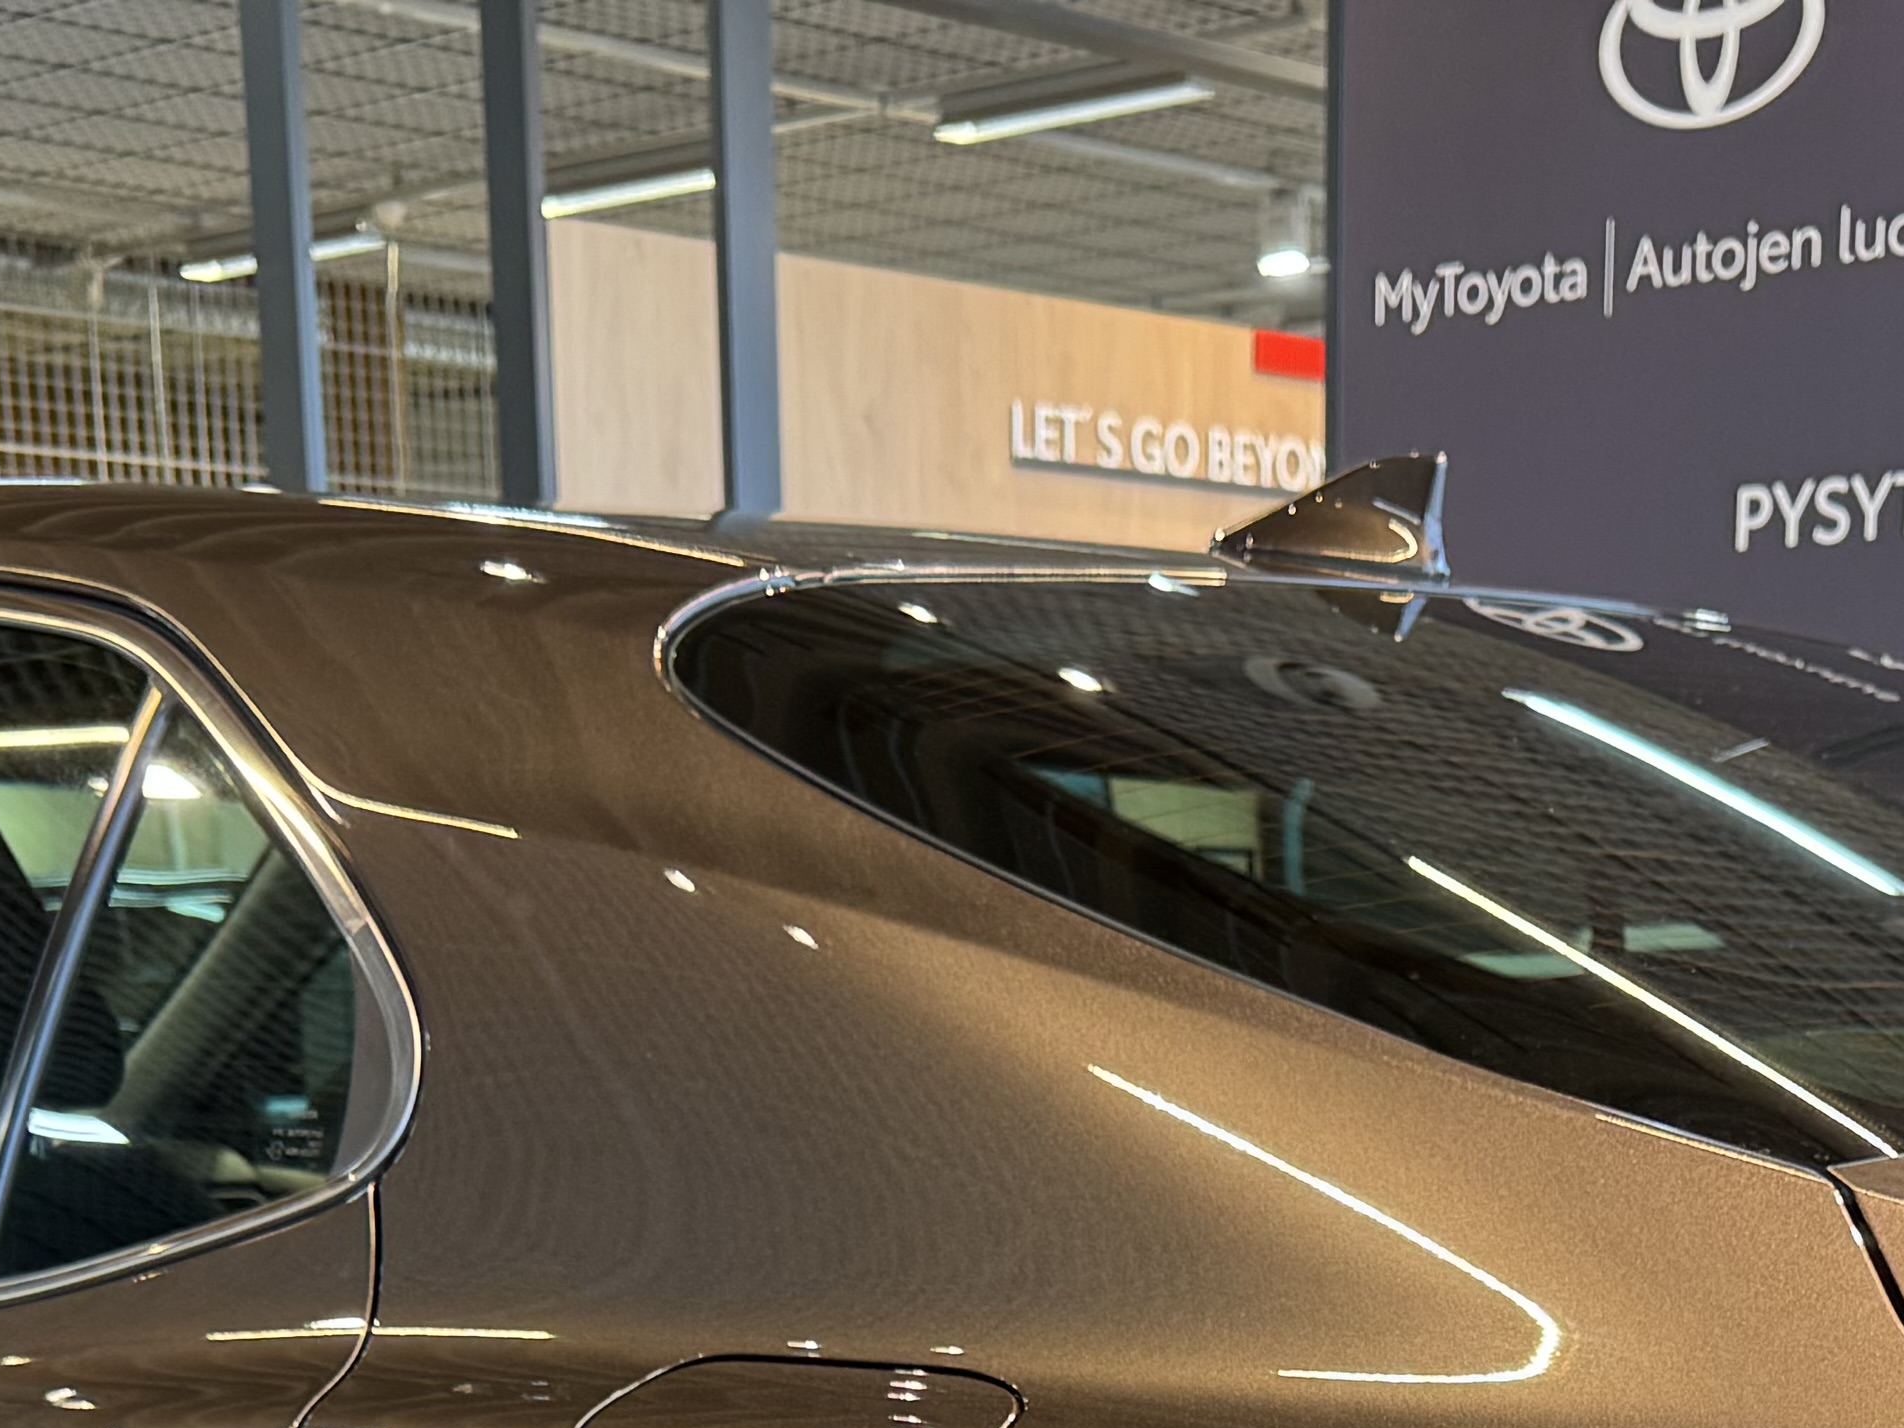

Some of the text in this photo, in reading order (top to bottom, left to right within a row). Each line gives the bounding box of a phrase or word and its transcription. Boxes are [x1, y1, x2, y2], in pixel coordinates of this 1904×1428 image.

[1374, 254, 1587, 334] MyToyota
[1627, 220, 1822, 291] Autojen
[1130, 414, 1201, 479] GO
[1207, 424, 1326, 493] BEYON
